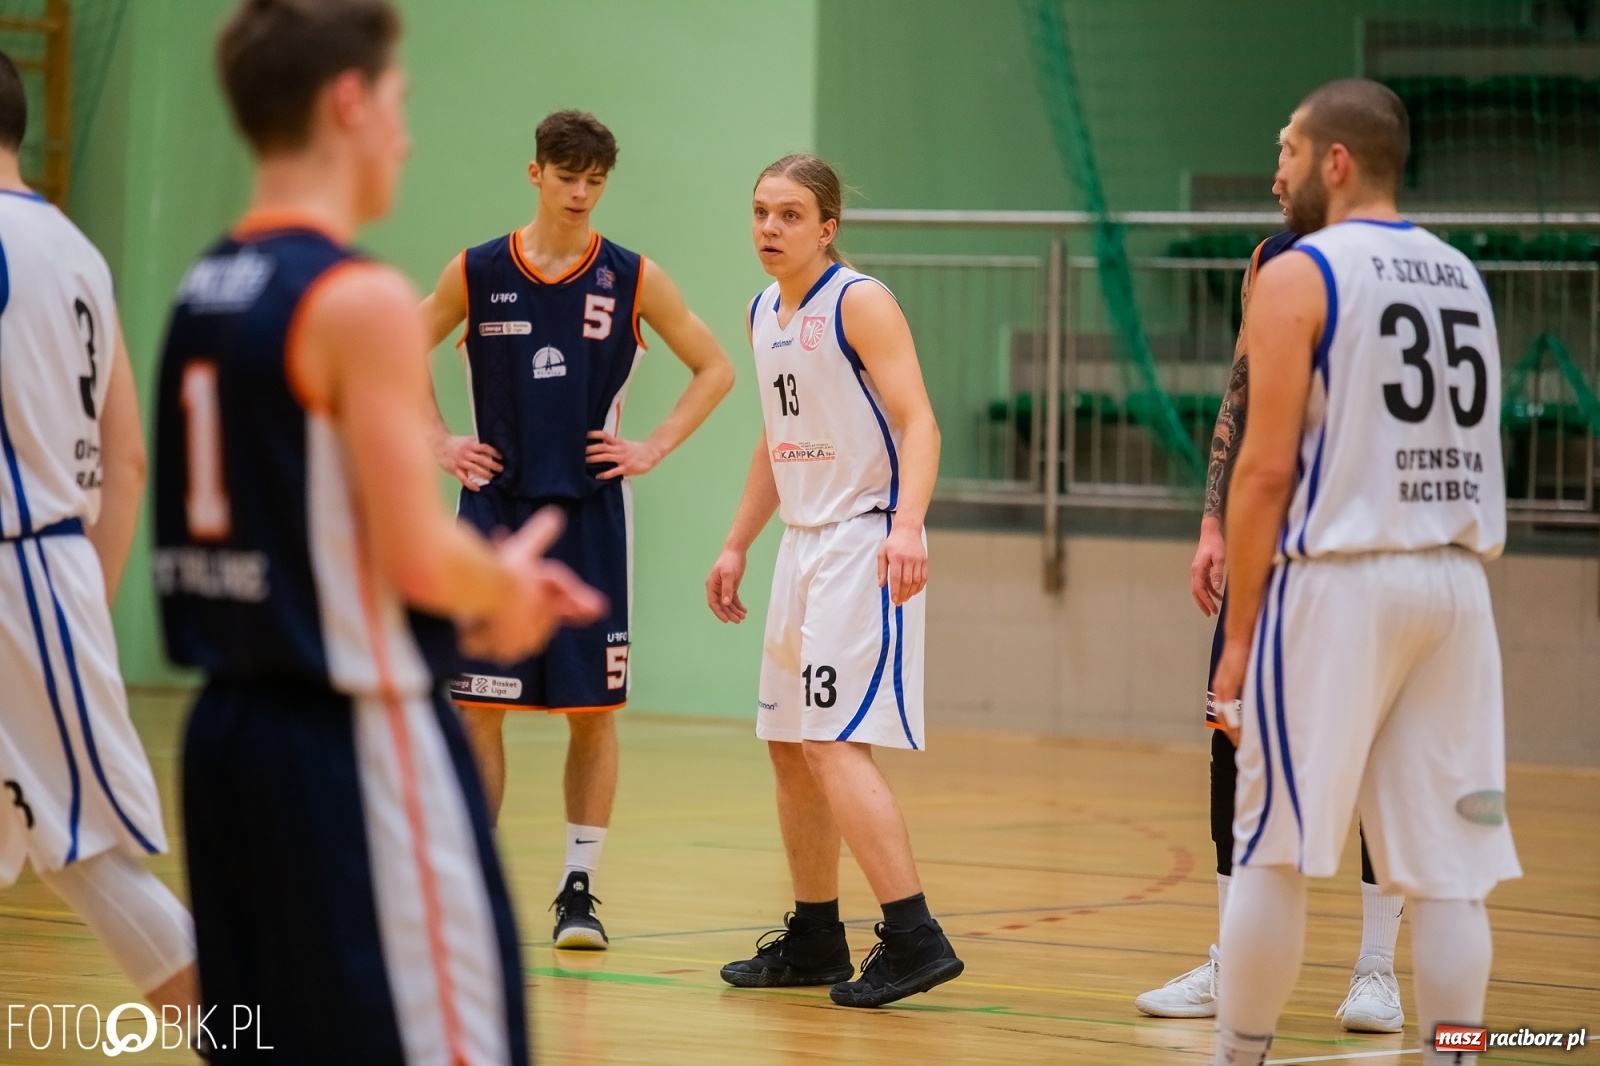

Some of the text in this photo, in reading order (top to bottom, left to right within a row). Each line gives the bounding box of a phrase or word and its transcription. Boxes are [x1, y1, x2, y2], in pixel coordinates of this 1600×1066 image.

[1371, 256, 1469, 290] P. SZKLARZ
[582, 293, 616, 340] 5
[1379, 302, 1488, 429] 35
[773, 373, 800, 417] 13
[181, 358, 232, 542] 1
[605, 645, 629, 691] 5
[801, 664, 837, 708] 13
